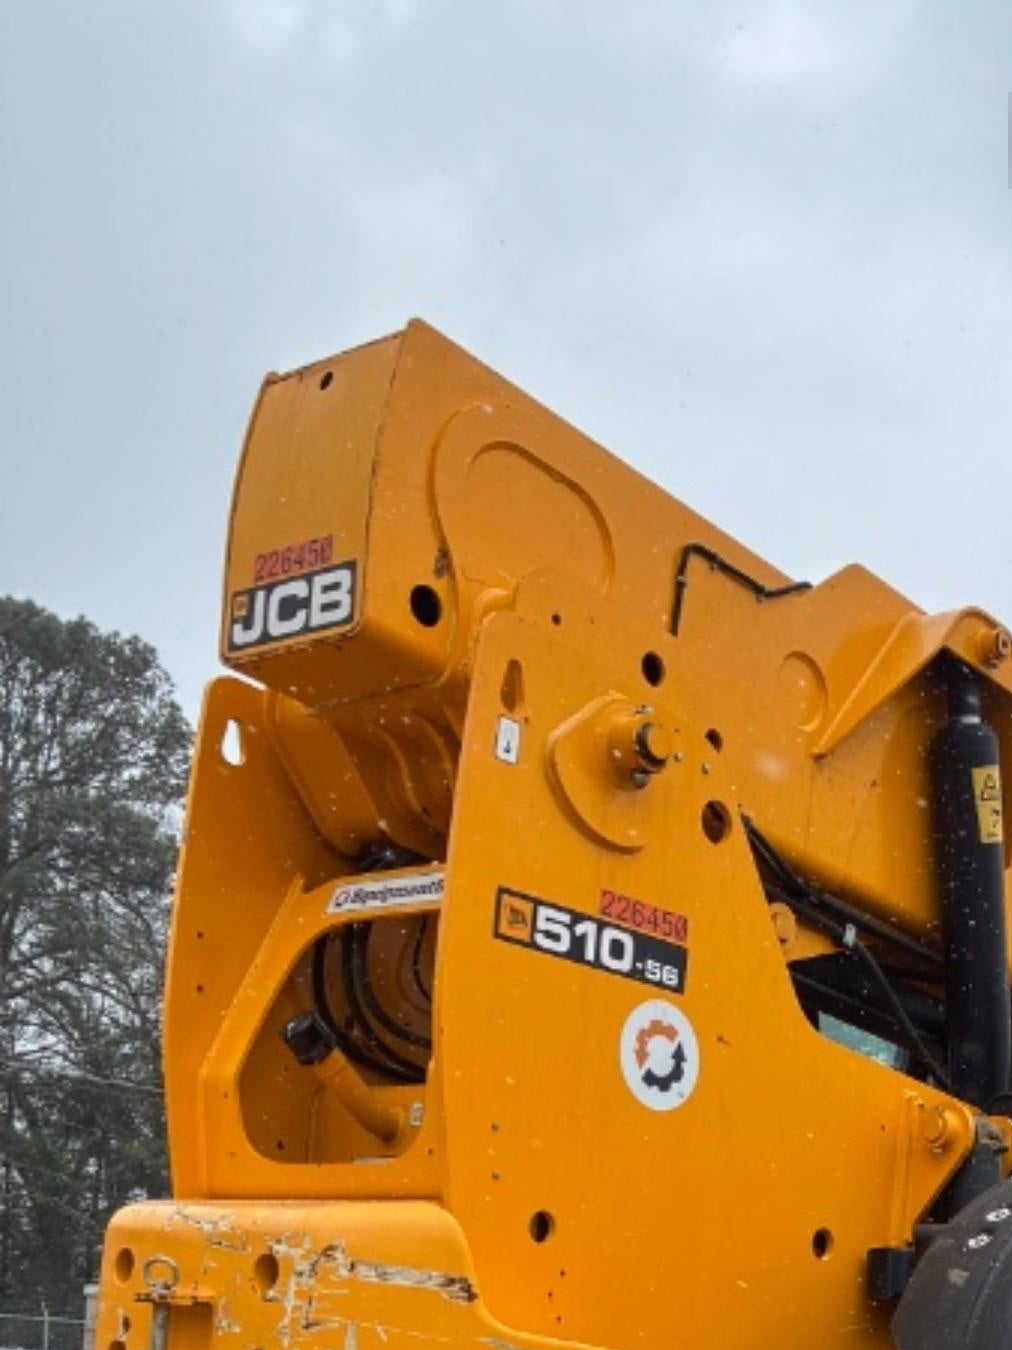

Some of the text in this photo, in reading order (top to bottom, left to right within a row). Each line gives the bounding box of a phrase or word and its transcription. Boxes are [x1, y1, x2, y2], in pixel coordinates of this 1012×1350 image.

[254, 533, 333, 581] 226450
[231, 567, 352, 646] JCB
[601, 889, 688, 942] 226450
